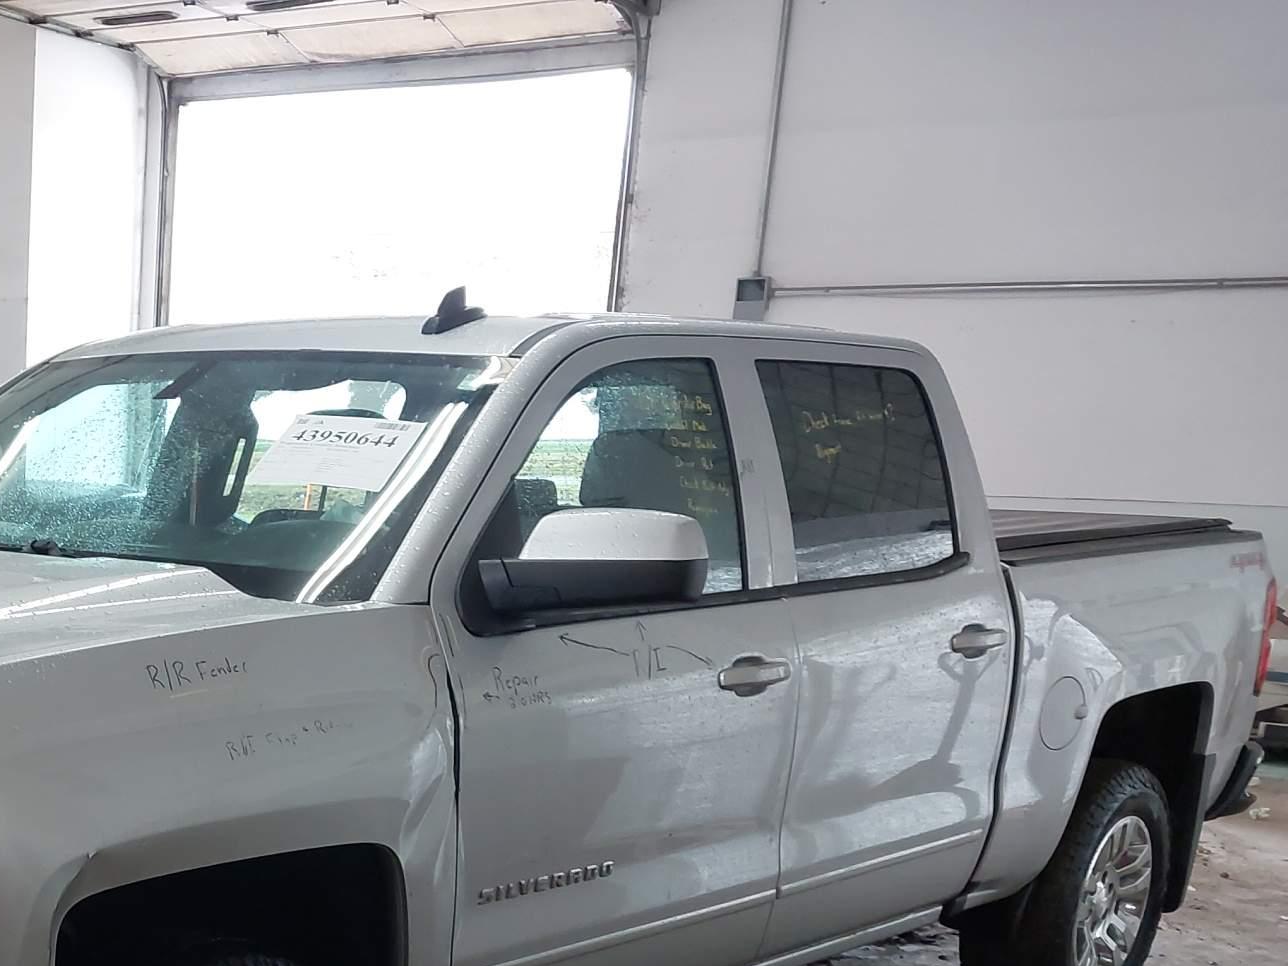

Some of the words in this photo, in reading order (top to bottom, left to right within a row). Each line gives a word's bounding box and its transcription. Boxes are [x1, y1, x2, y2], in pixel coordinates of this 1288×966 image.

[291, 428, 400, 448] 43950644
[145, 659, 192, 692] R/R
[195, 657, 248, 681] Fender
[491, 665, 539, 697] Repair
[477, 860, 615, 906] SILVERADO
